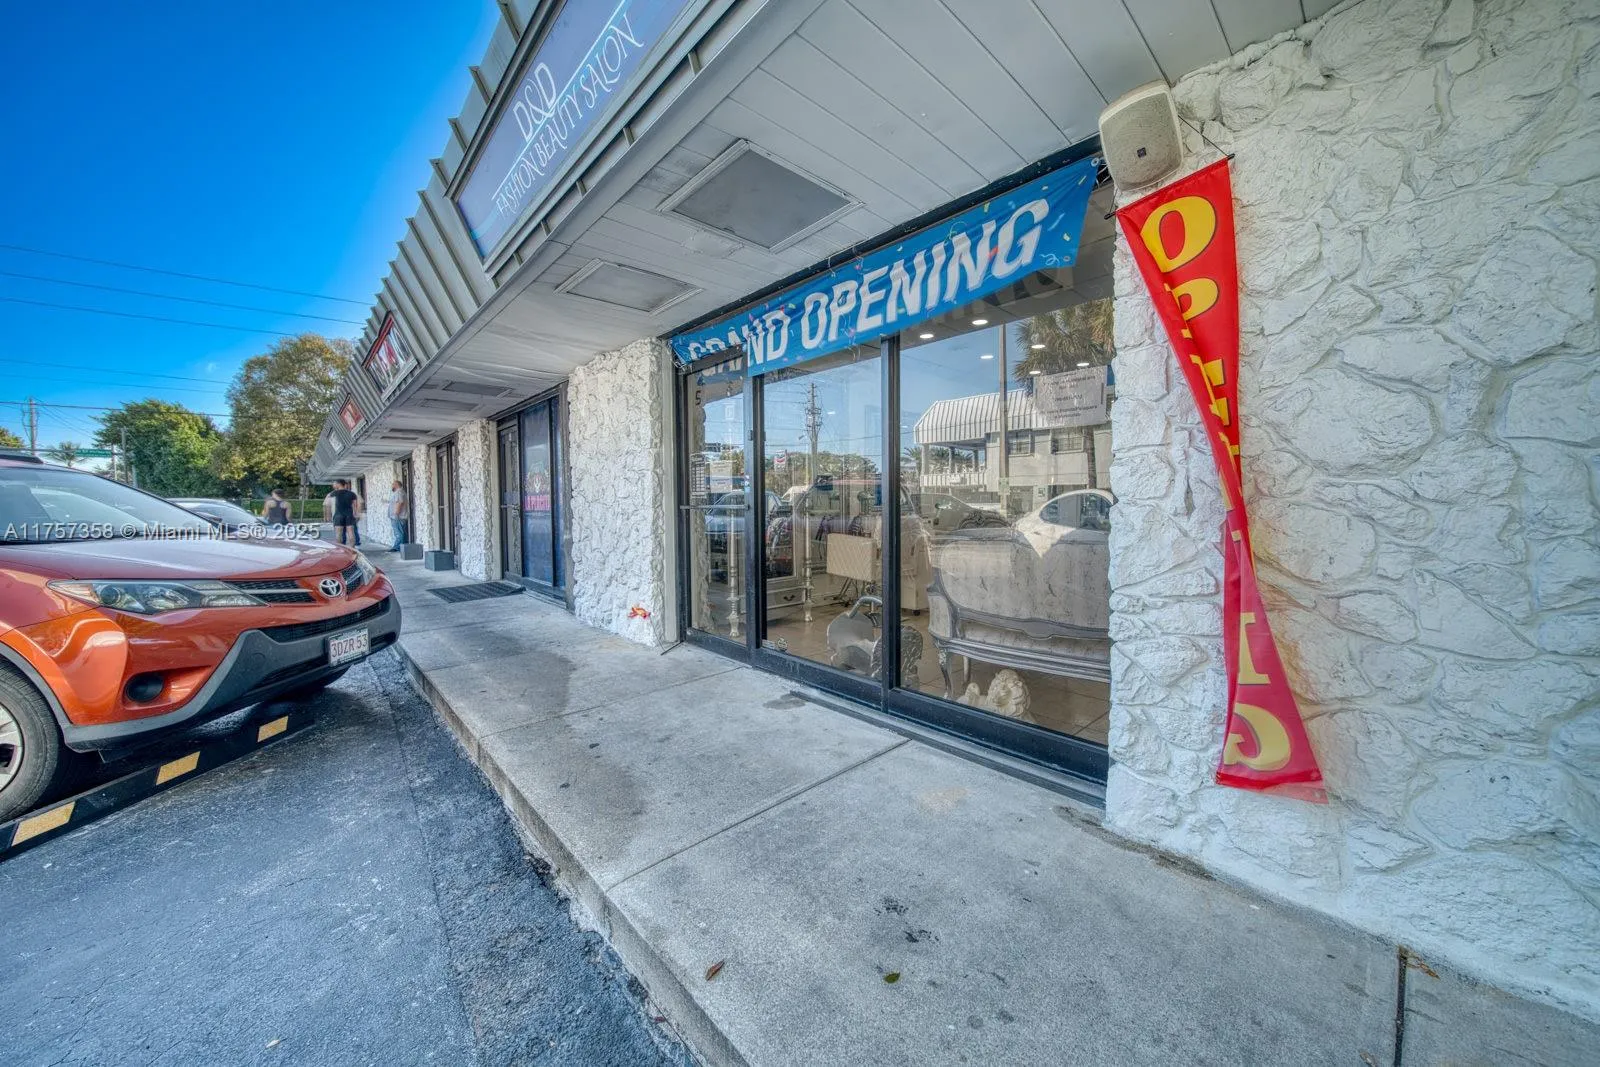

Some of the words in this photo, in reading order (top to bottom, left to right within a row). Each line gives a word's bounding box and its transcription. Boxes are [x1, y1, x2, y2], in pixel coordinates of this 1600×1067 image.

[496, 150, 545, 219] FASHION
[534, 83, 583, 168] BEAUTY
[580, 12, 644, 109] SALON
[801, 199, 1049, 349] OPENING
[331, 639, 354, 658] 3DZR
[356, 634, 368, 649] 53
